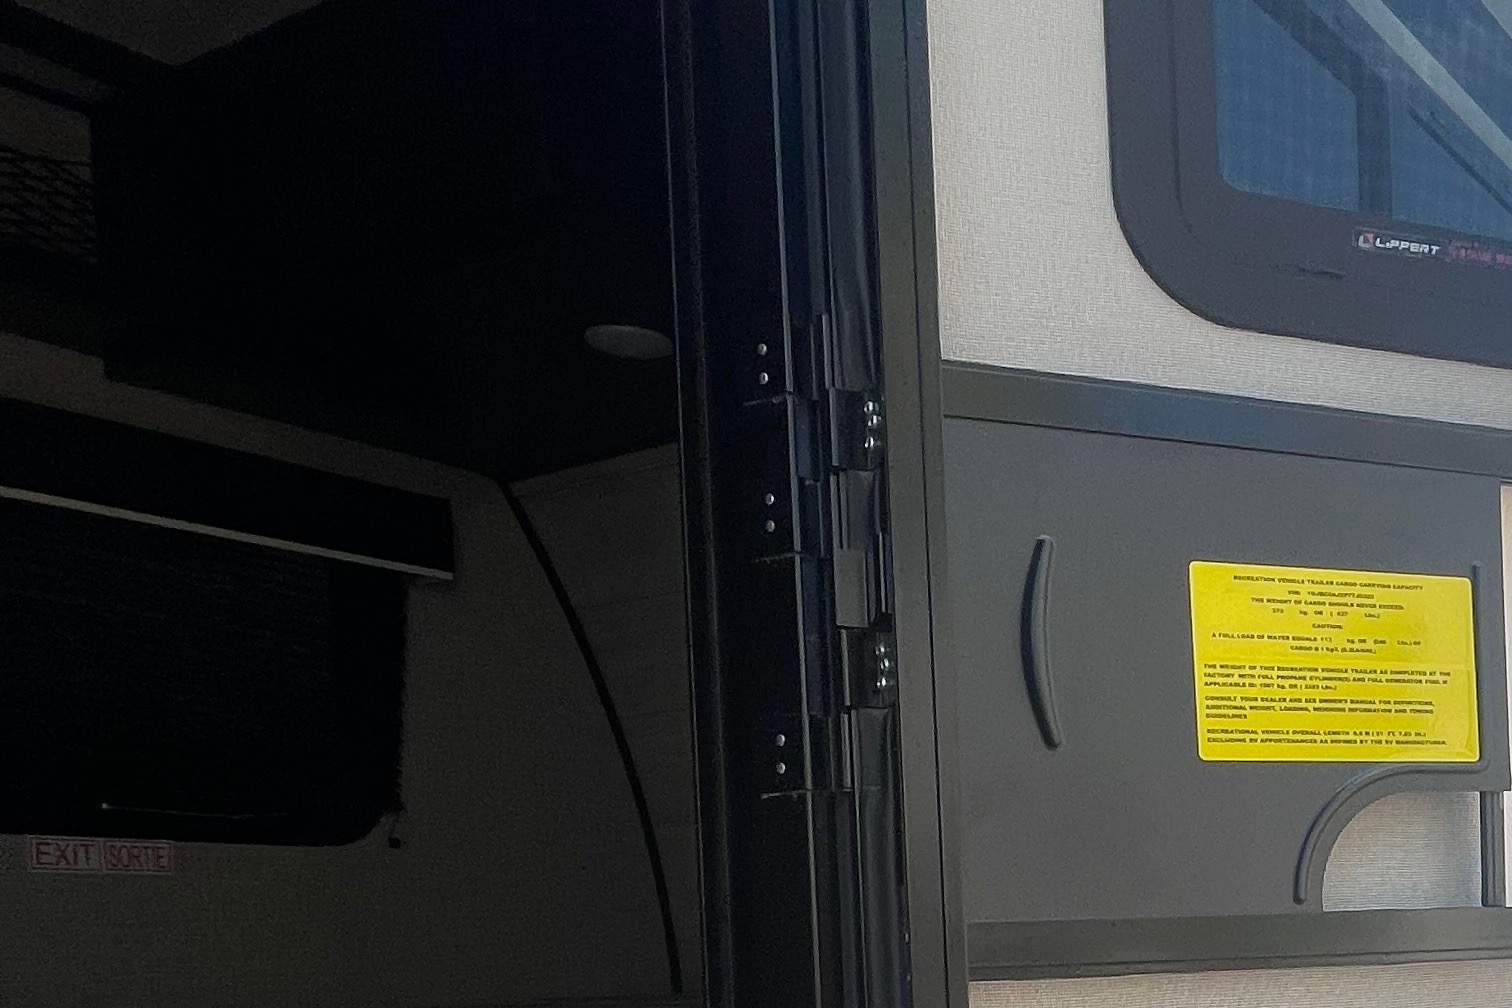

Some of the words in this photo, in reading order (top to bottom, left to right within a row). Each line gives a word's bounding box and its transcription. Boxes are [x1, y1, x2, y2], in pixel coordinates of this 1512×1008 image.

[1375, 237, 1440, 255] LIPPERT
[35, 841, 94, 866] EXIT
[107, 844, 165, 869] SORTIE
